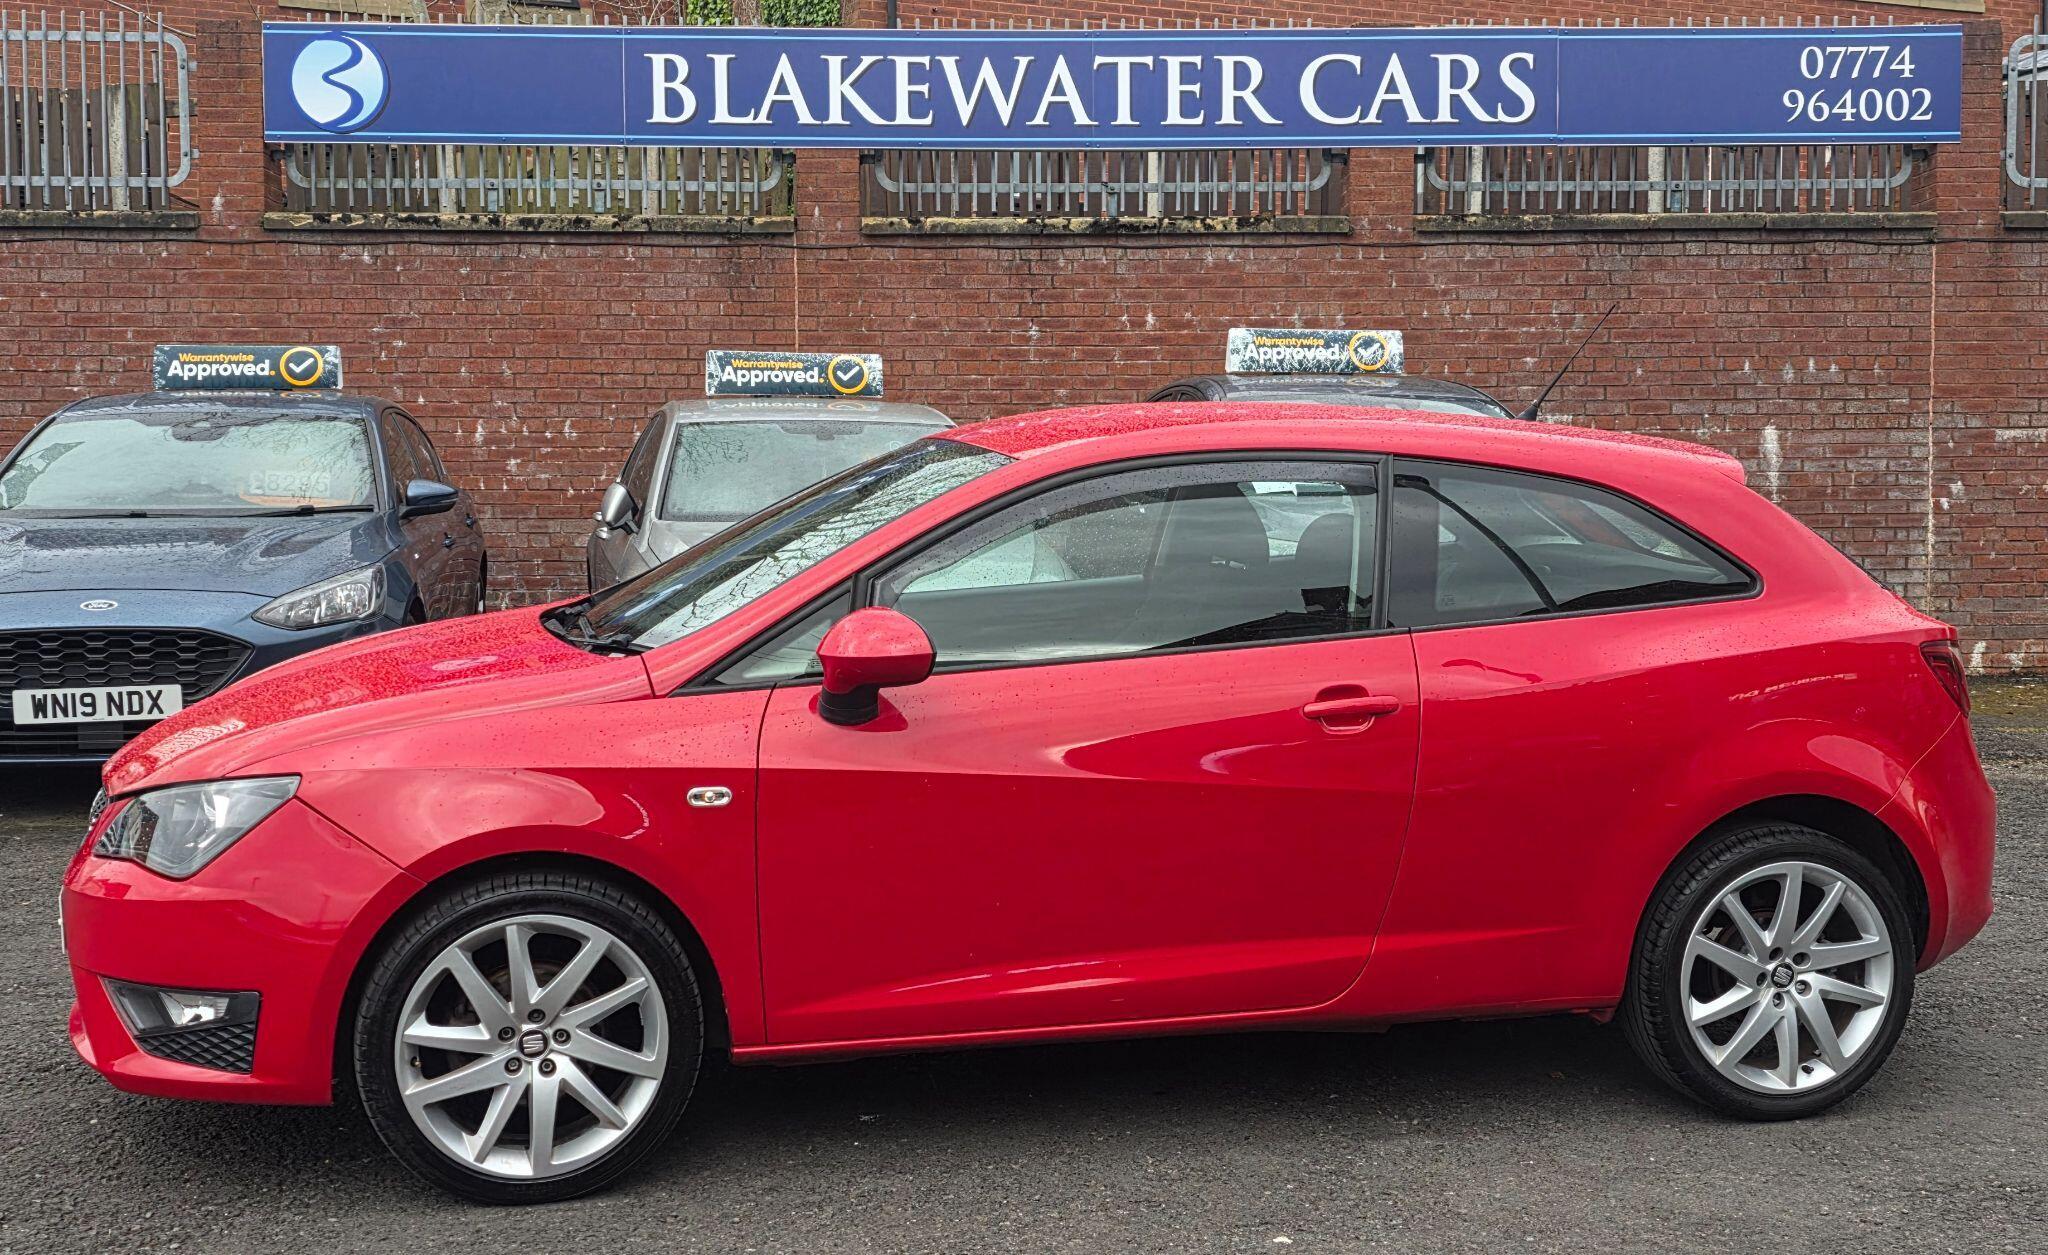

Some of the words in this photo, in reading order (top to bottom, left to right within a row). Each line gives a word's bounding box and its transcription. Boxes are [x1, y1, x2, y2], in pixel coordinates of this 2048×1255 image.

[1799, 44, 1916, 80] 07774
[643, 53, 1284, 127] BLAKEWATER
[1299, 52, 1536, 125] CARS
[1781, 87, 1934, 123] 964002
[179, 352, 255, 363] Warrantywise
[1245, 343, 1344, 363] Approved
[167, 359, 276, 381] Approved.
[731, 359, 804, 370] Warrantywise
[721, 366, 825, 387] Approved.
[30, 692, 97, 719] WN19
[105, 689, 165, 717] NDX
